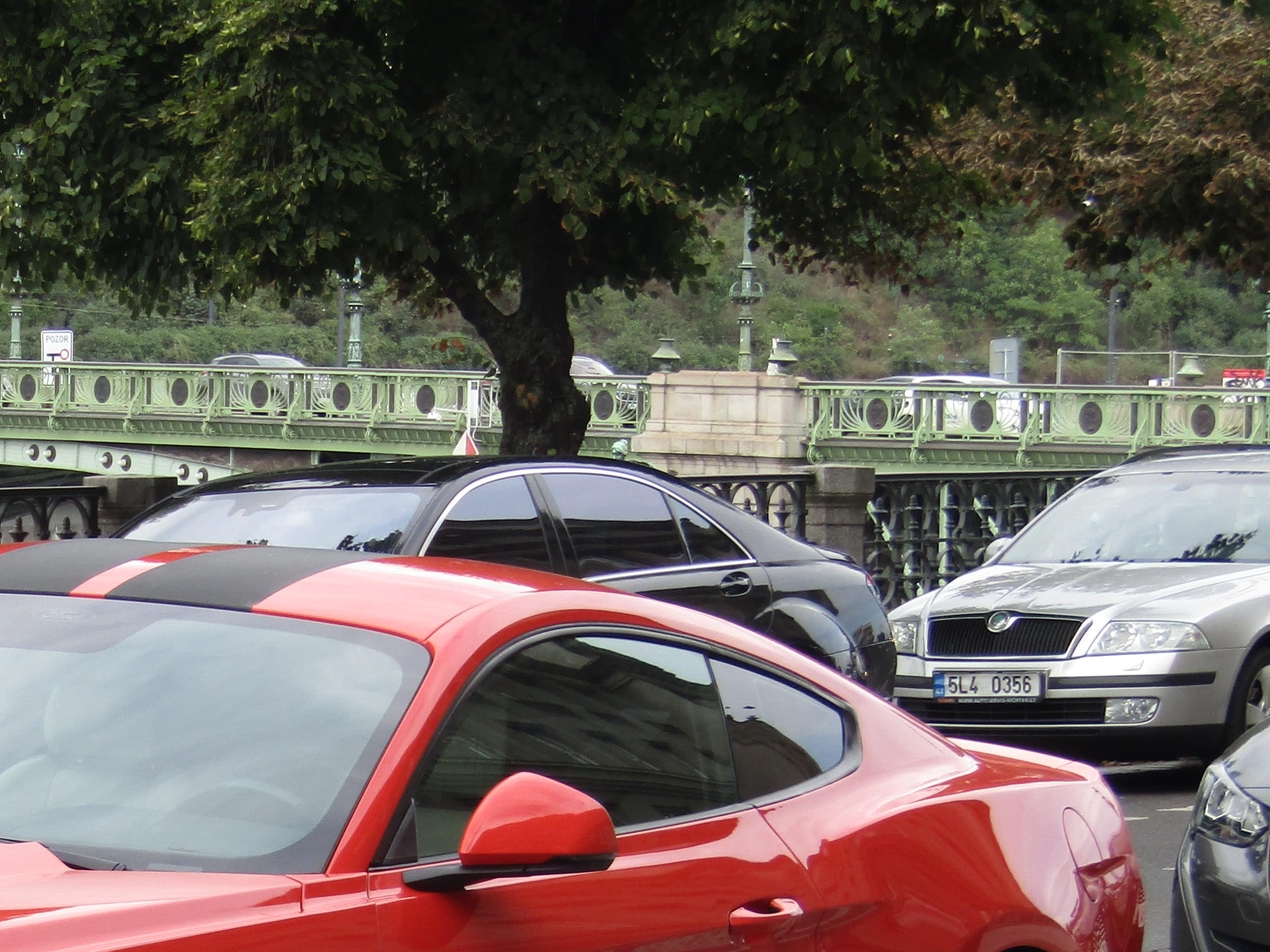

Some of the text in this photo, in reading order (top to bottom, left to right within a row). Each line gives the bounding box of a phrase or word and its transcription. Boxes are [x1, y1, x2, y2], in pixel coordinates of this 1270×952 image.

[45, 335, 69, 343] POZOR
[948, 675, 1032, 694] 5L4 0356
